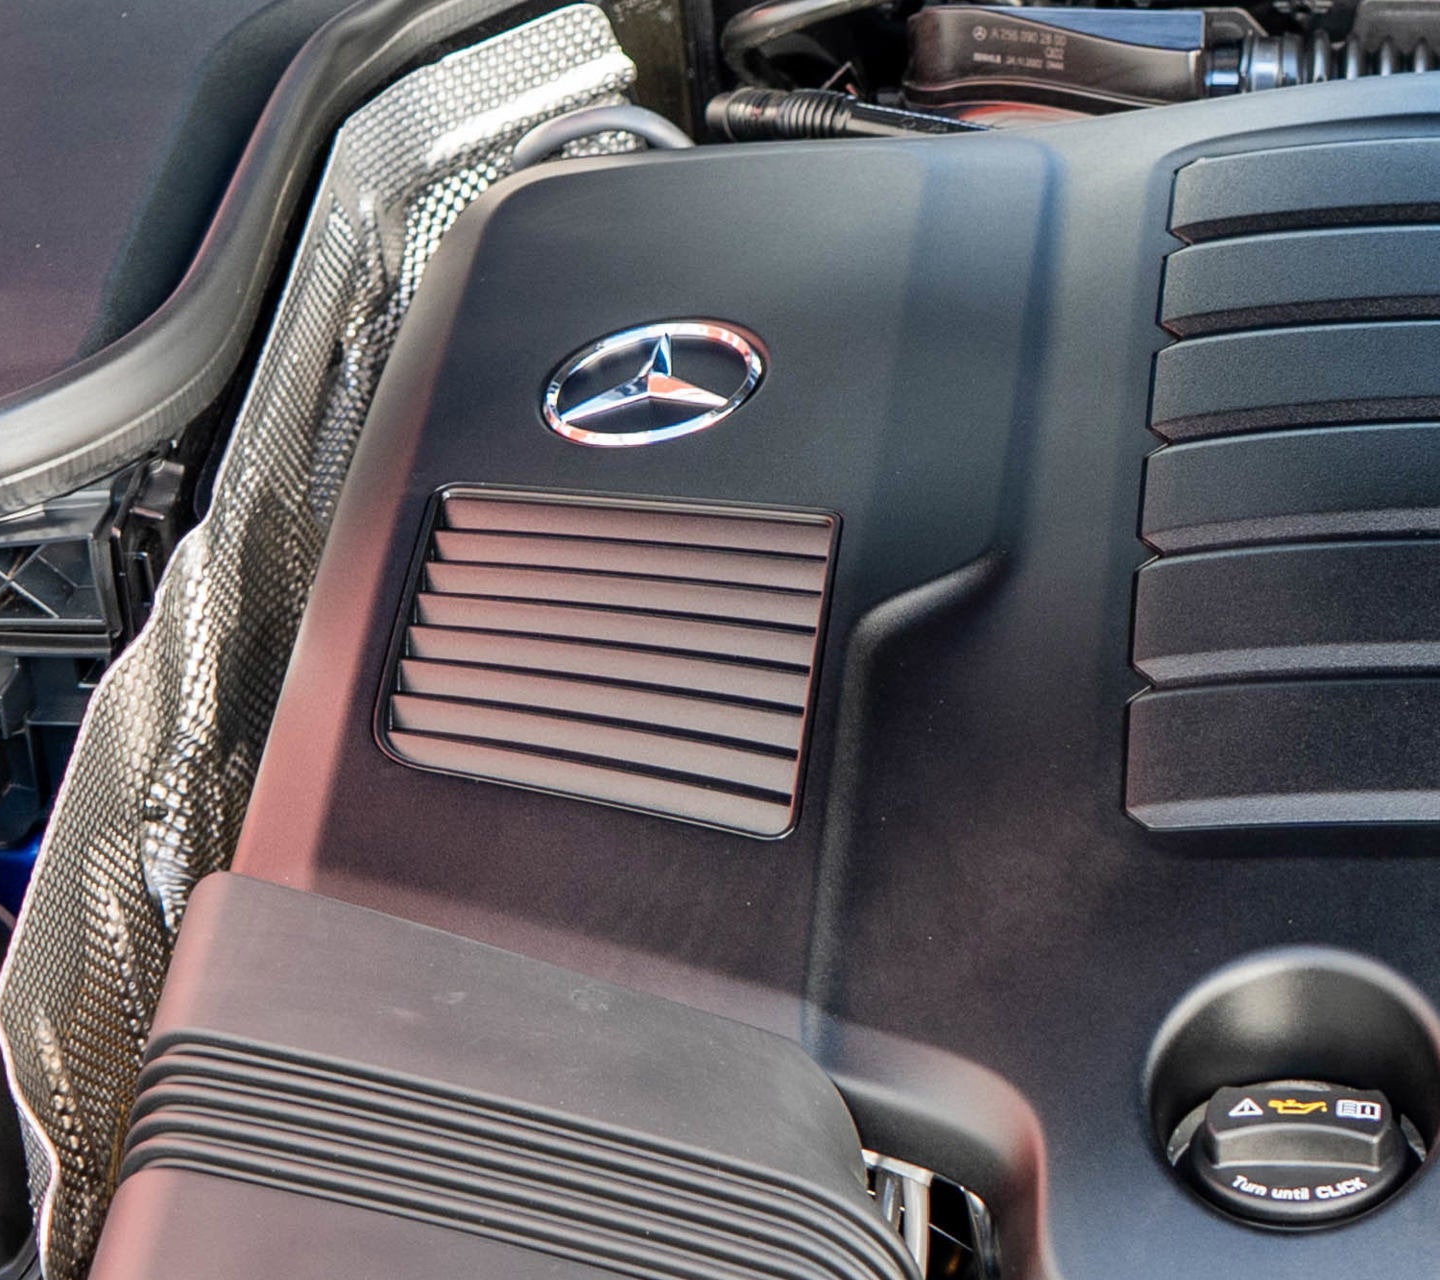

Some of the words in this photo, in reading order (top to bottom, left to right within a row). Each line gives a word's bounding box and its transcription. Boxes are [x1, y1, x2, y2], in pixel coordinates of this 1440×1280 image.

[1231, 1175, 1266, 1198] Turn
[1271, 1186, 1310, 1201] until
[1315, 1176, 1368, 1200] CLICK
